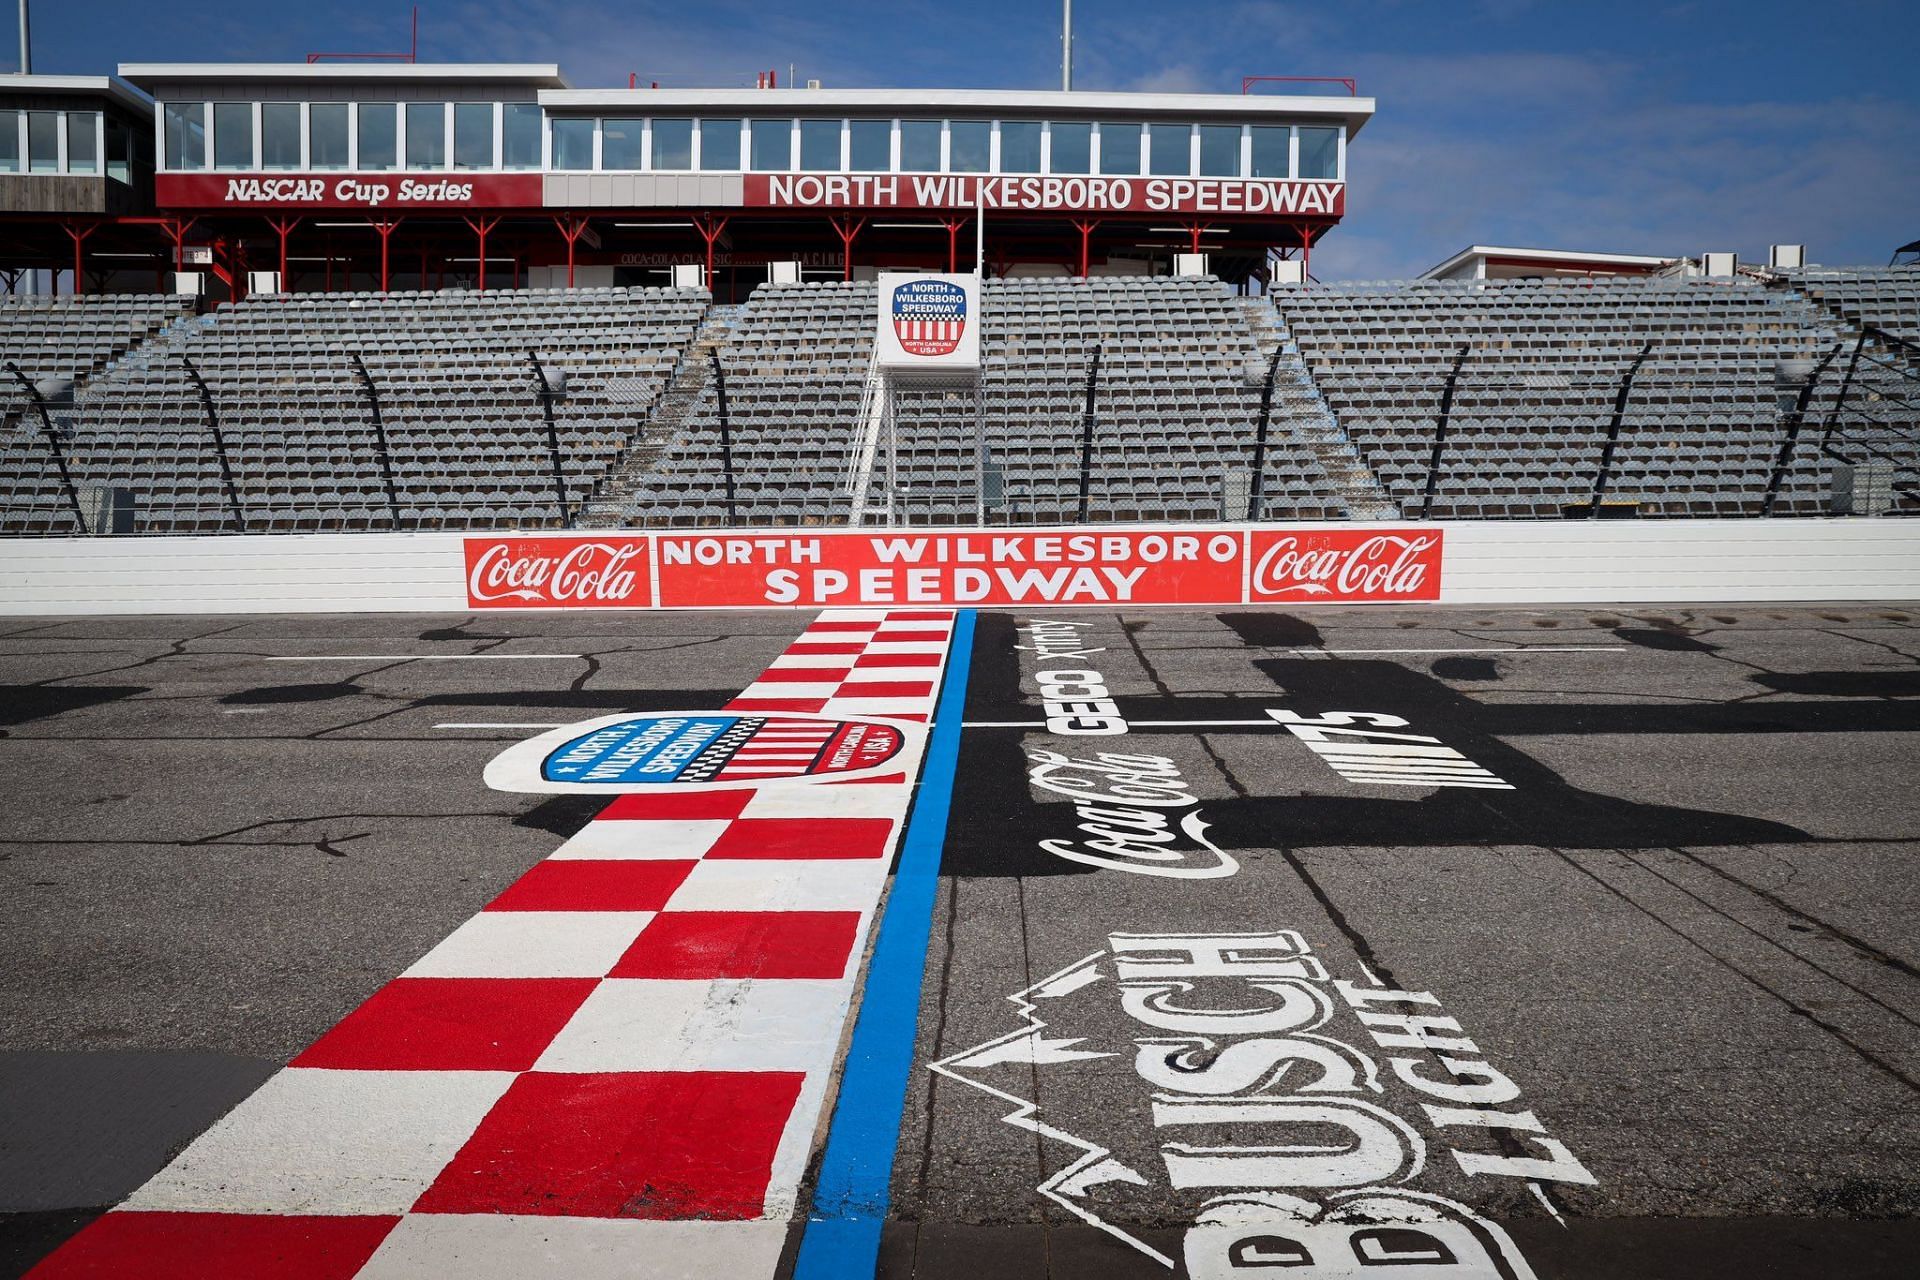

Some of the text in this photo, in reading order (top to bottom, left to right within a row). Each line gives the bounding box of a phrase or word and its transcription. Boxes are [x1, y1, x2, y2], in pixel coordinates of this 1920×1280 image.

[225, 178, 473, 206] NASCAR Cup Series
[767, 174, 1344, 215] NORTH WILKESBORO SPEEDWAY
[621, 253, 679, 264] COCA-COLA
[682, 252, 731, 264] CLASIC
[895, 294, 964, 303] WILKESBORO
[901, 303, 958, 313] SPEEDWAY
[912, 284, 948, 293] NORTH
[663, 534, 1239, 566] NORTH WILKESBORO
[1253, 535, 1440, 595] Coca-Cola
[470, 542, 646, 601] Coca-Cola
[764, 566, 1149, 604] SPEEDWAY
[1035, 669, 1129, 736] GEICO
[556, 730, 623, 763] NORTH
[580, 718, 689, 781] WILKESBORO
[639, 722, 723, 774] SPEEDWAY
[861, 736, 893, 753] USA
[1027, 748, 1241, 880] Coca-Cola
[1333, 977, 1600, 1187] LIGHT
[1107, 929, 1541, 1280] BUSCH
